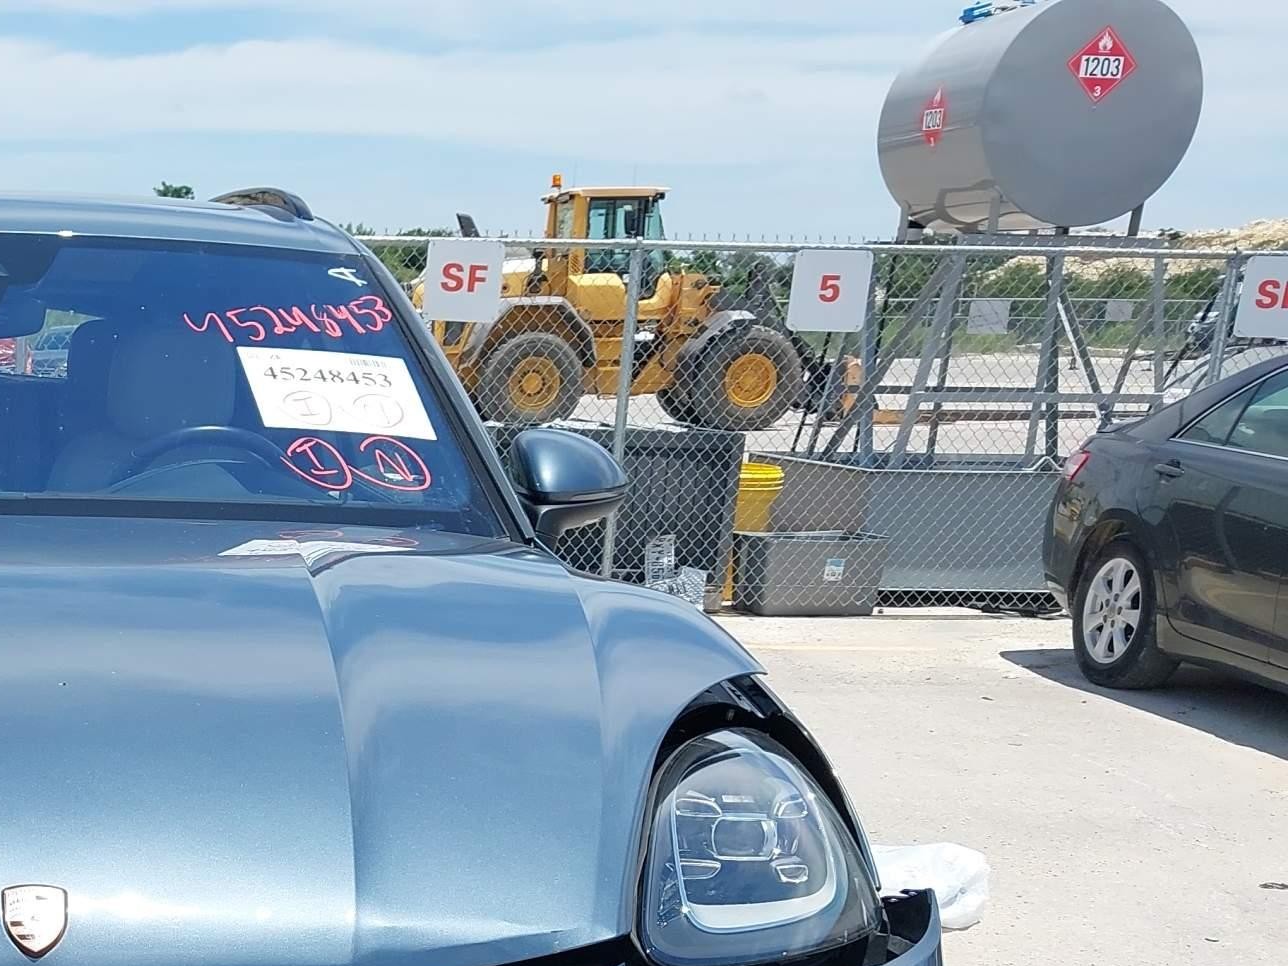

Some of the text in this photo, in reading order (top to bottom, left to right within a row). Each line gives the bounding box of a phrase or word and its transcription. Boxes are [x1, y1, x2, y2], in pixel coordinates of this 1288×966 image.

[1084, 57, 1121, 77] 1203
[1093, 85, 1102, 97] 3
[924, 110, 942, 129] 1203
[440, 262, 488, 293] SF
[819, 274, 841, 303] 5
[183, 295, 393, 343] 45248453
[264, 366, 392, 388] 45248453
